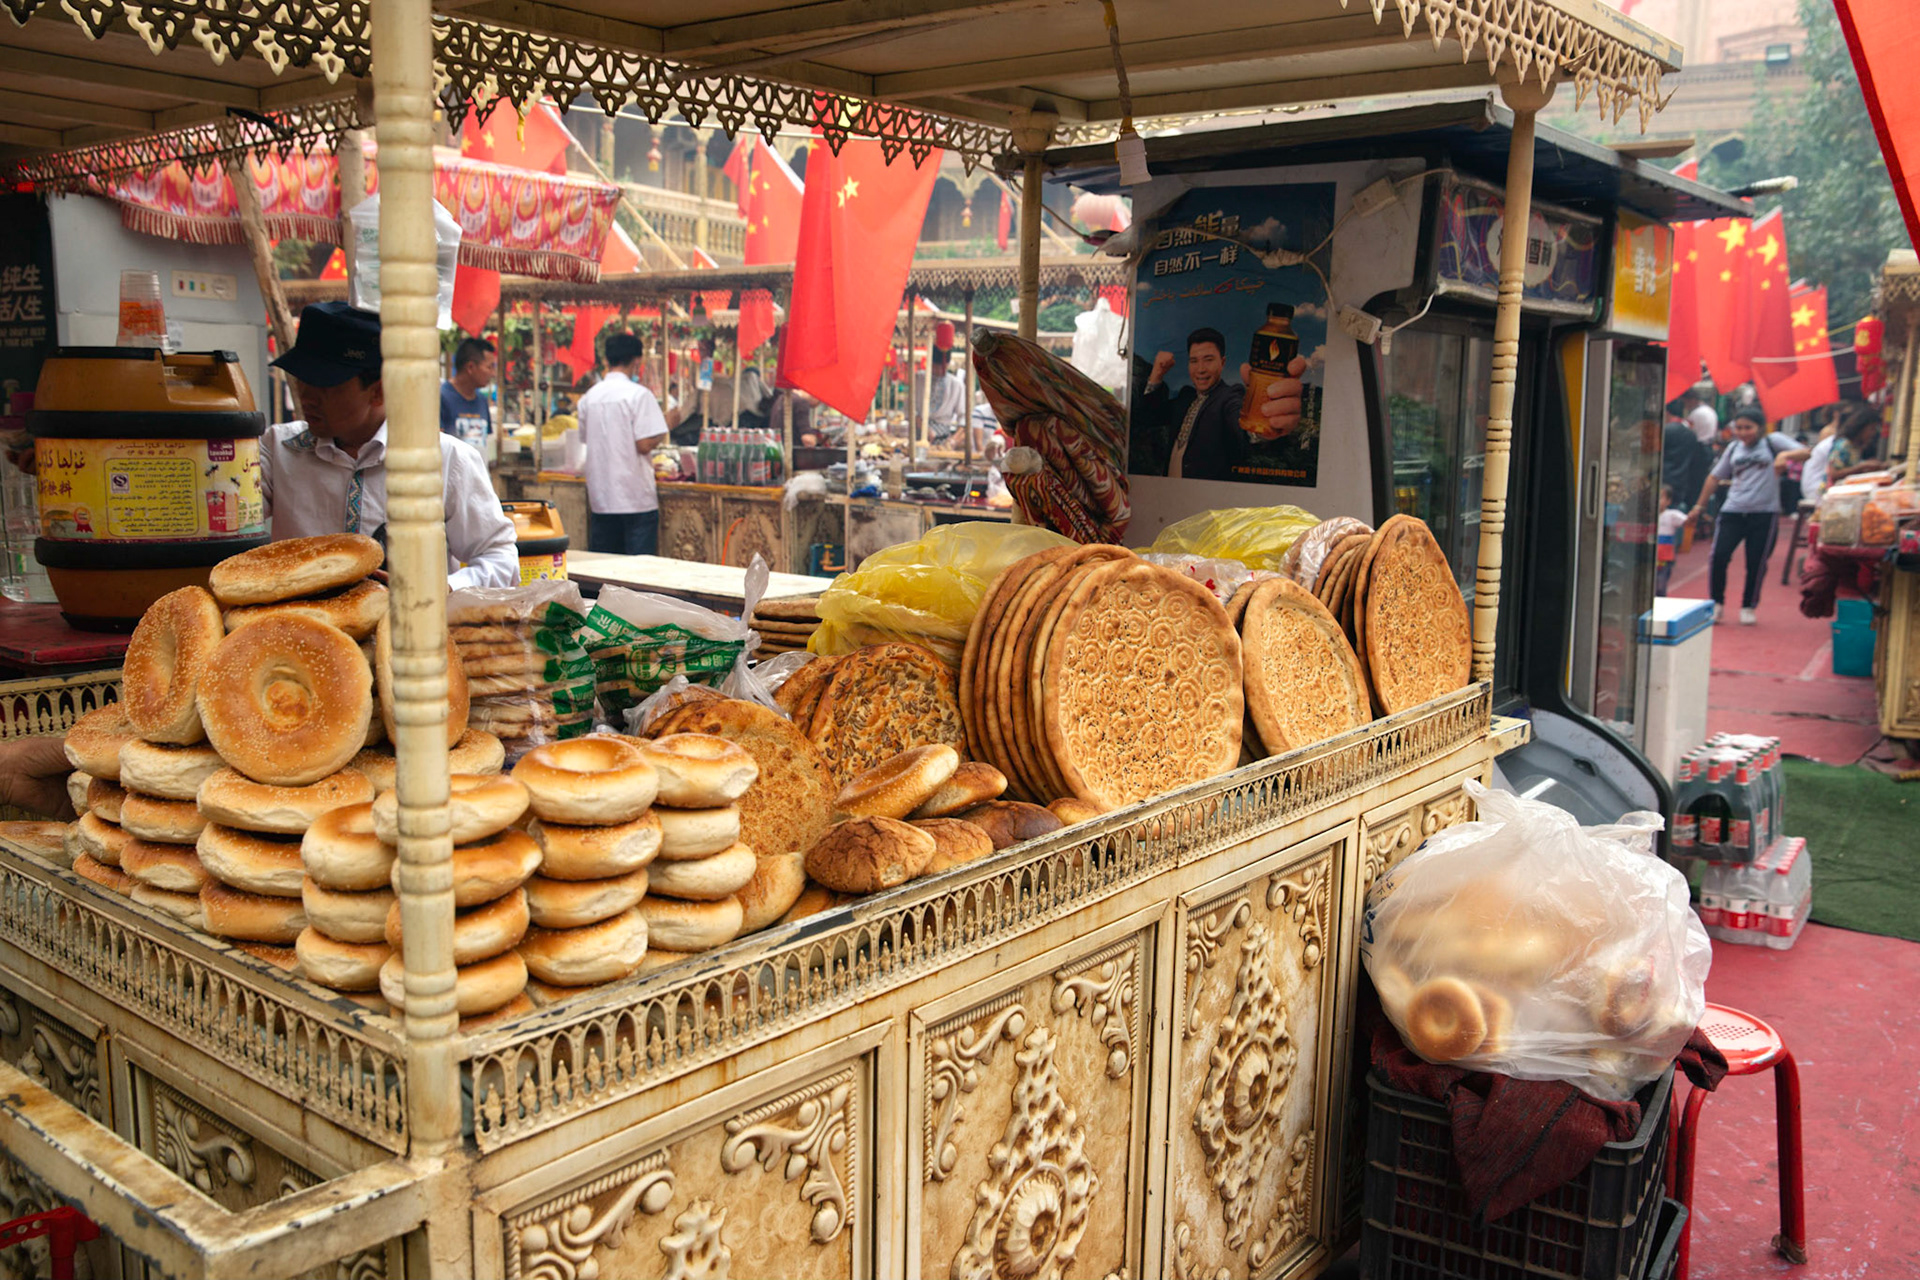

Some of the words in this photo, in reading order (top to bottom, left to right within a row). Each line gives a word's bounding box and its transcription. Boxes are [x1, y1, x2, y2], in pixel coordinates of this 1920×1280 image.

[1153, 244, 1239, 277] 自然不一样
